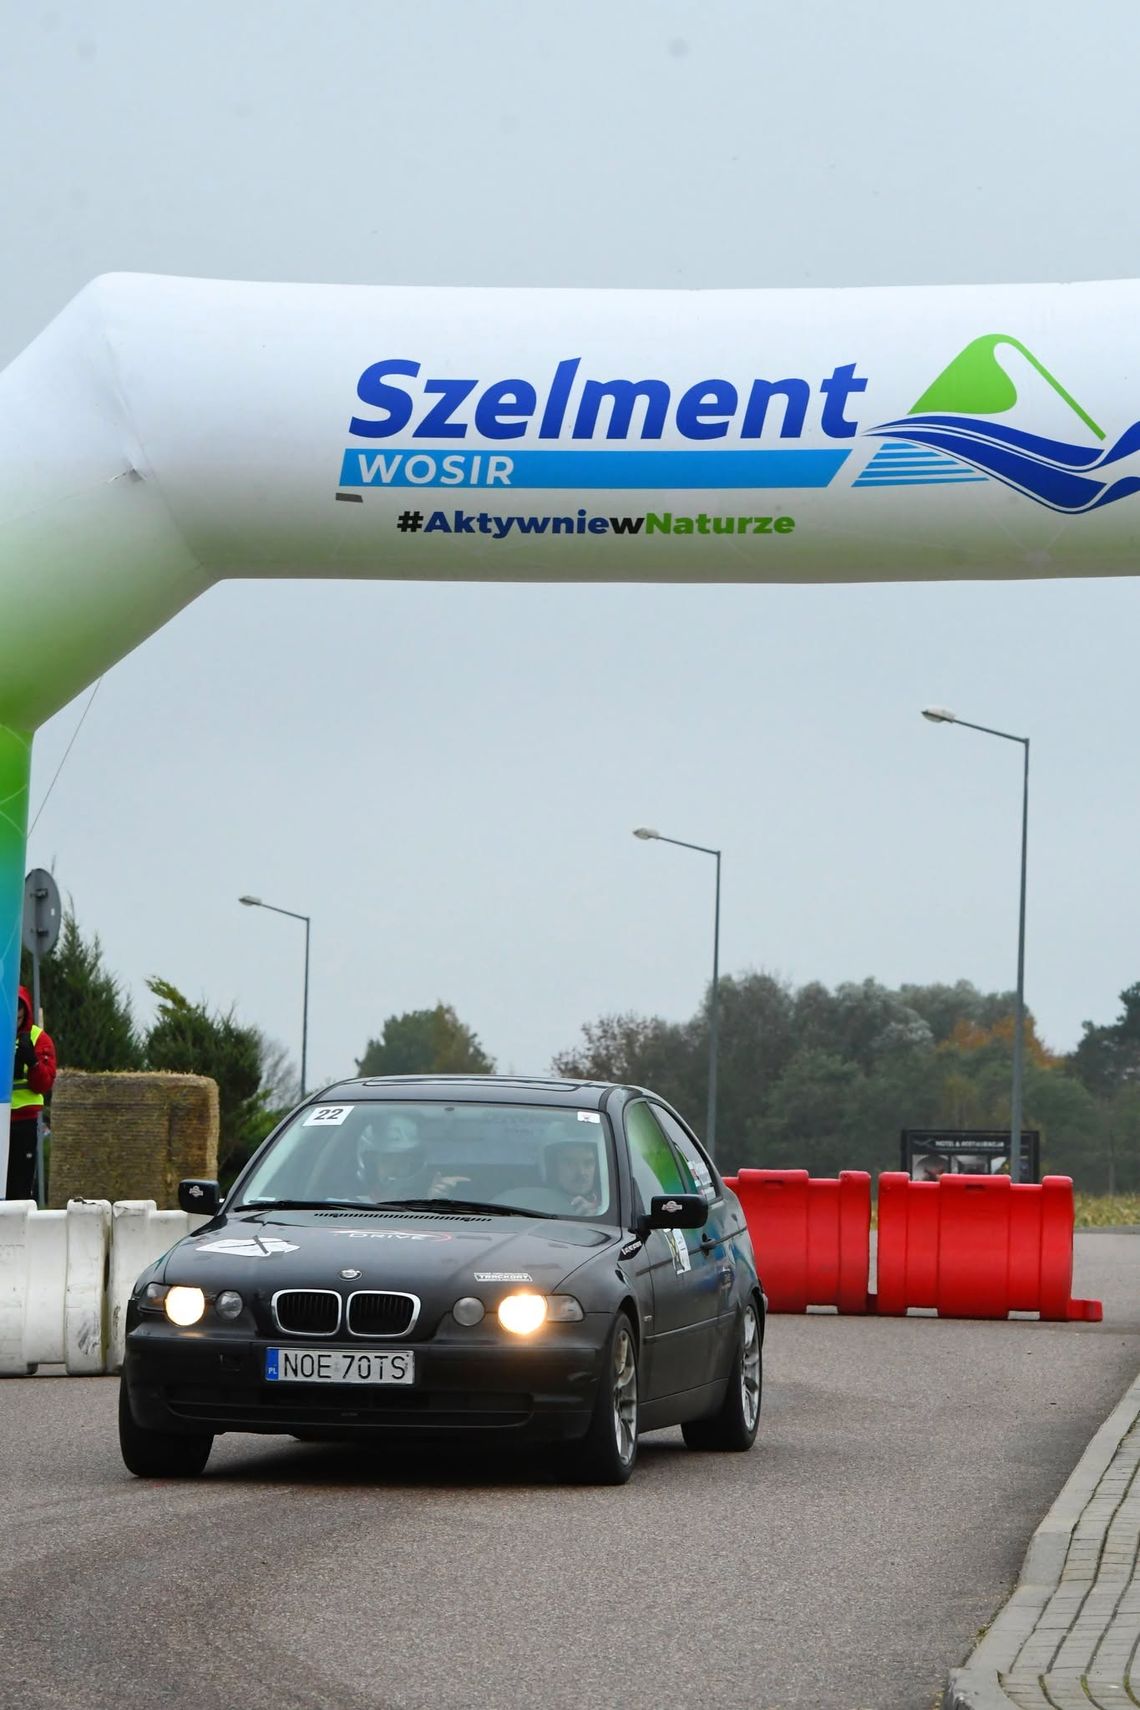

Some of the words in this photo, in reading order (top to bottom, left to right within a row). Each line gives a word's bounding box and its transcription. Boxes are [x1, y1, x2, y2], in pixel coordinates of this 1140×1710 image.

[349, 357, 868, 440] Szelment
[357, 454, 515, 485] WOSIR
[397, 509, 796, 539] #AktywniewNaturze
[313, 1108, 344, 1120] 22
[283, 1352, 332, 1379] NOE
[342, 1354, 405, 1380] 70TS
